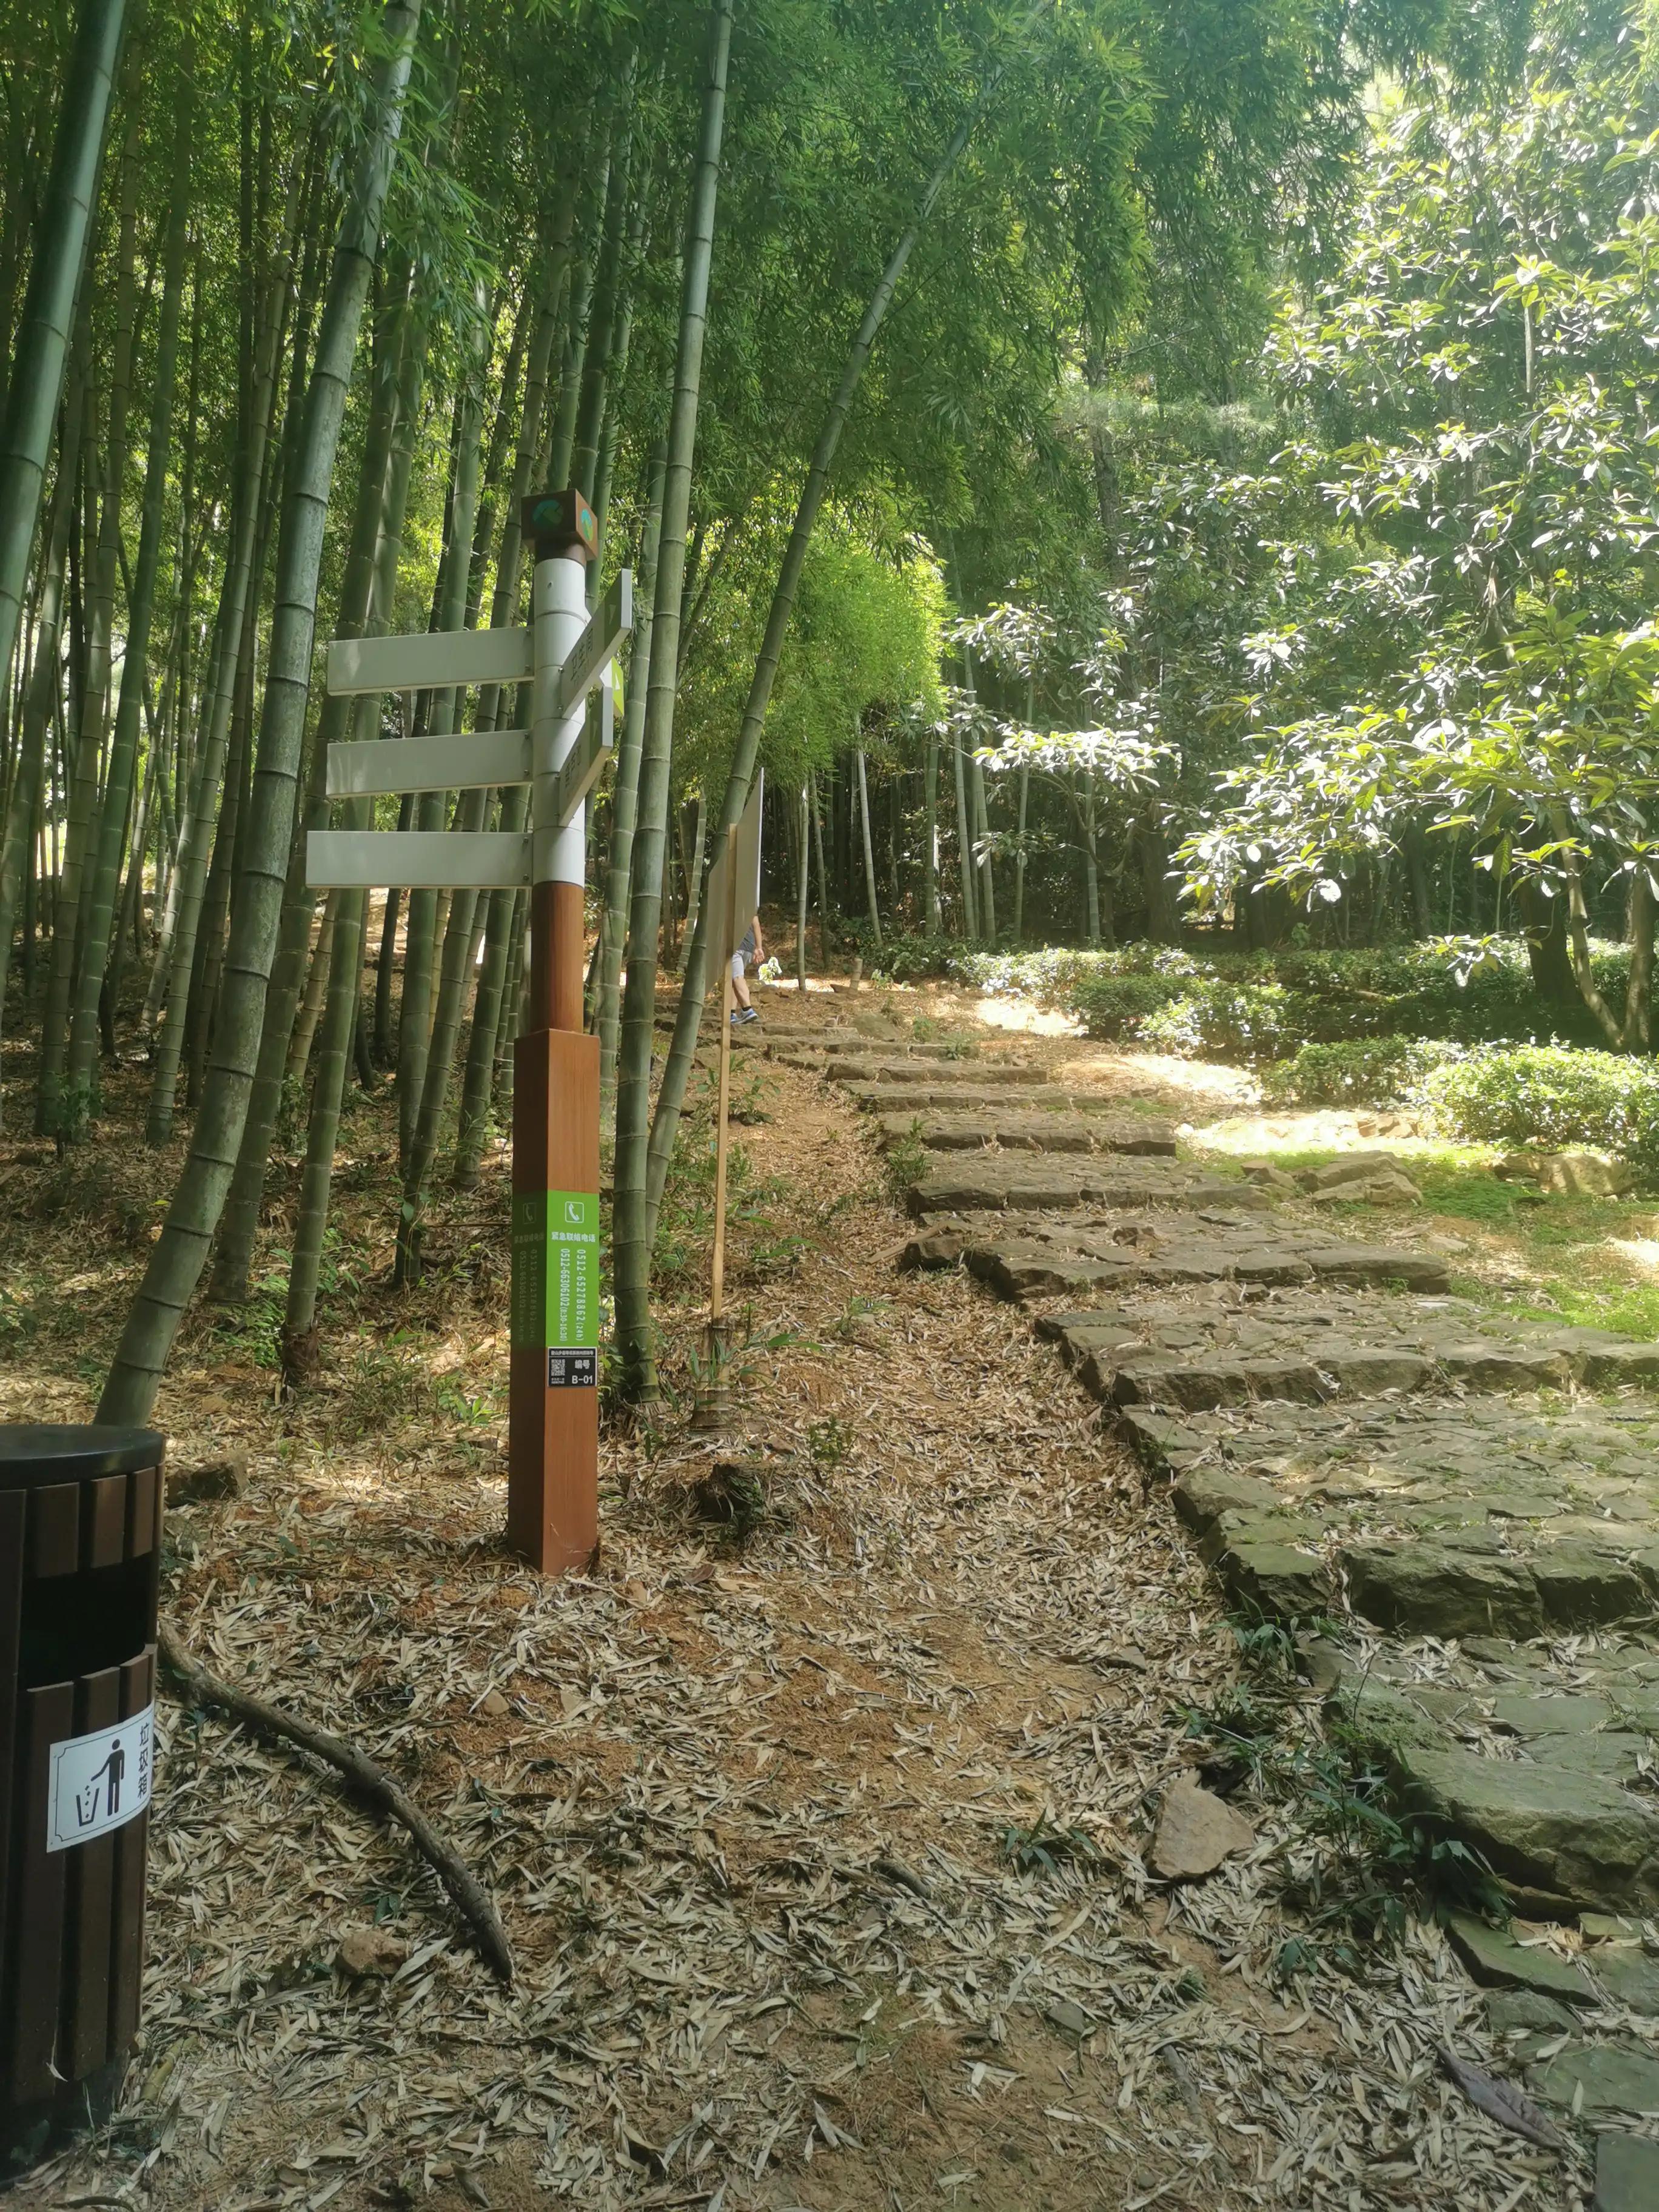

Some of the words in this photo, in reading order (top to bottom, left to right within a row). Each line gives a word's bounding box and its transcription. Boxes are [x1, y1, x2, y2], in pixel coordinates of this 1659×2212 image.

[572, 1375, 592, 1384] B-01
[137, 1721, 150, 1799] 垃圾箱
